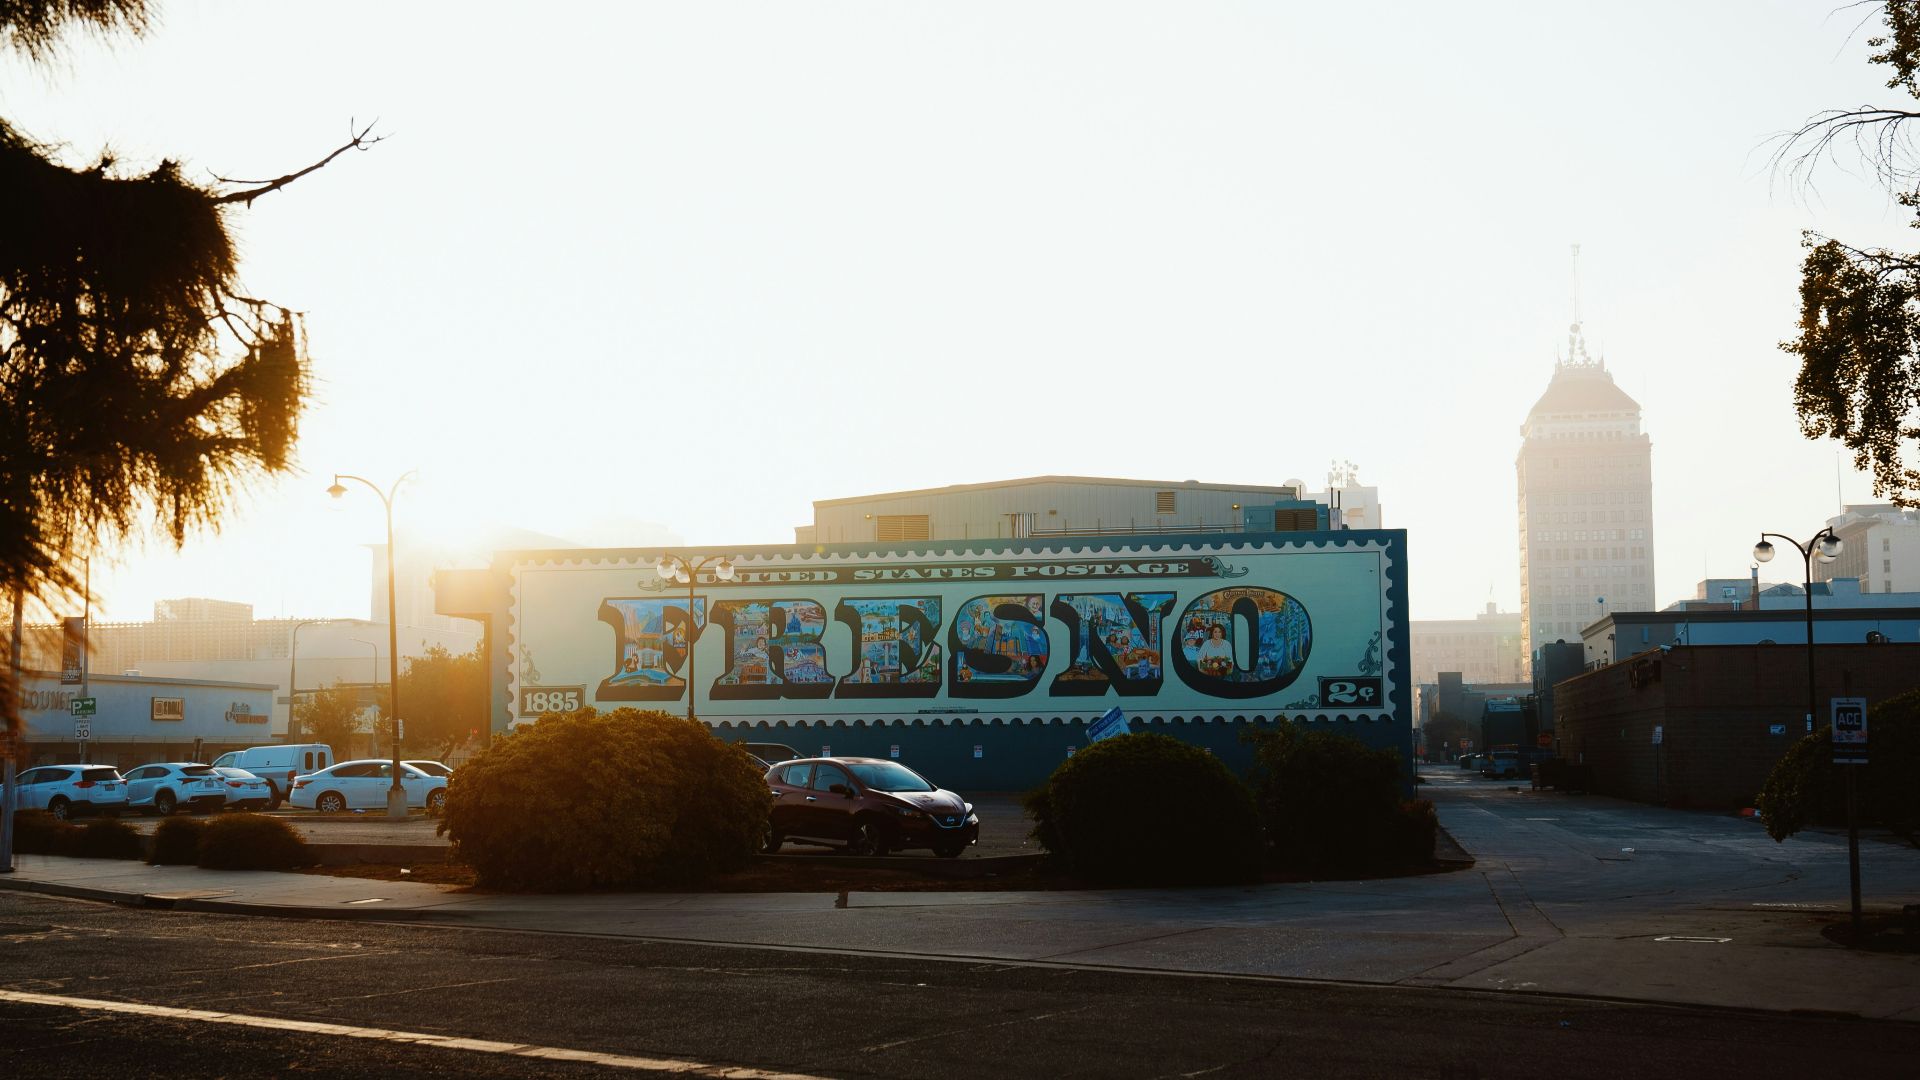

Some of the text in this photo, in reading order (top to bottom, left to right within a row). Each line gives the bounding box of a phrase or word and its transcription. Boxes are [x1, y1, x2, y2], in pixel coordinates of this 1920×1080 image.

[853, 566, 996, 580] STATES
[1011, 562, 1190, 576] POSTAGE
[596, 586, 1313, 702] FRESNO
[525, 691, 579, 712] 1885
[76, 729, 89, 738] 30
